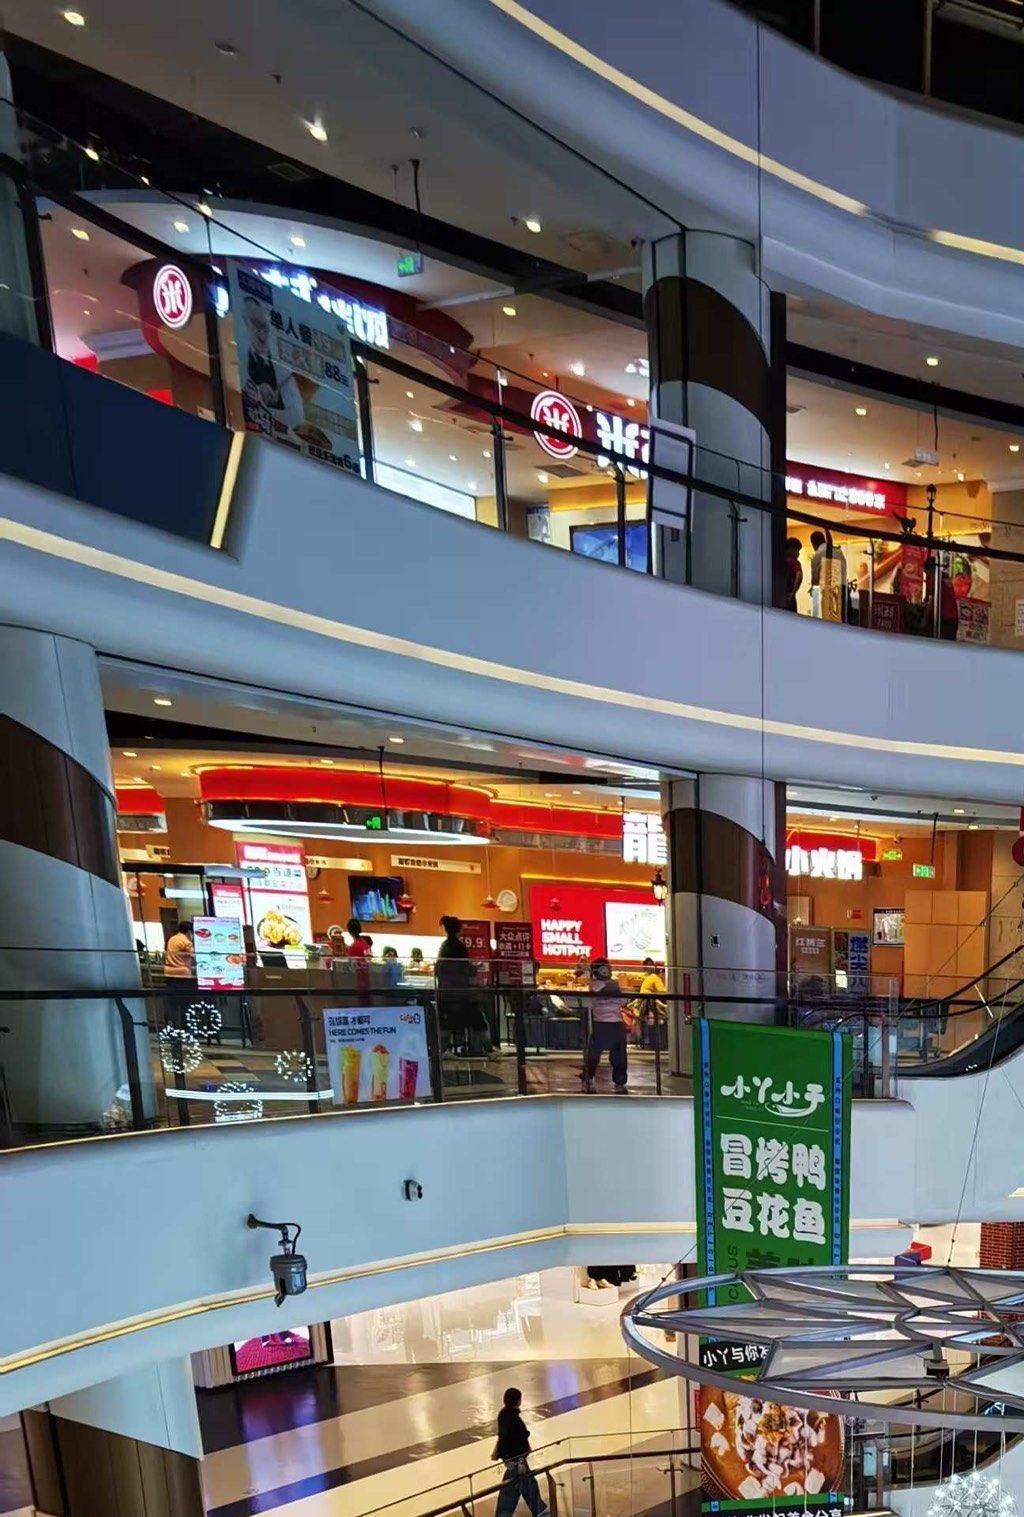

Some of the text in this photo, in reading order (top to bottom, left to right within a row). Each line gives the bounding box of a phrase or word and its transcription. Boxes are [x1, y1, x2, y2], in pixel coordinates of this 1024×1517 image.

[540, 917, 583, 934] HAPPY
[541, 931, 584, 945] SMALL
[542, 944, 593, 957] HOTPOT
[347, 1027, 370, 1036] COMES
[720, 1133, 826, 1191] 冒烤鸭
[722, 1187, 826, 1245] 豆花鱼
